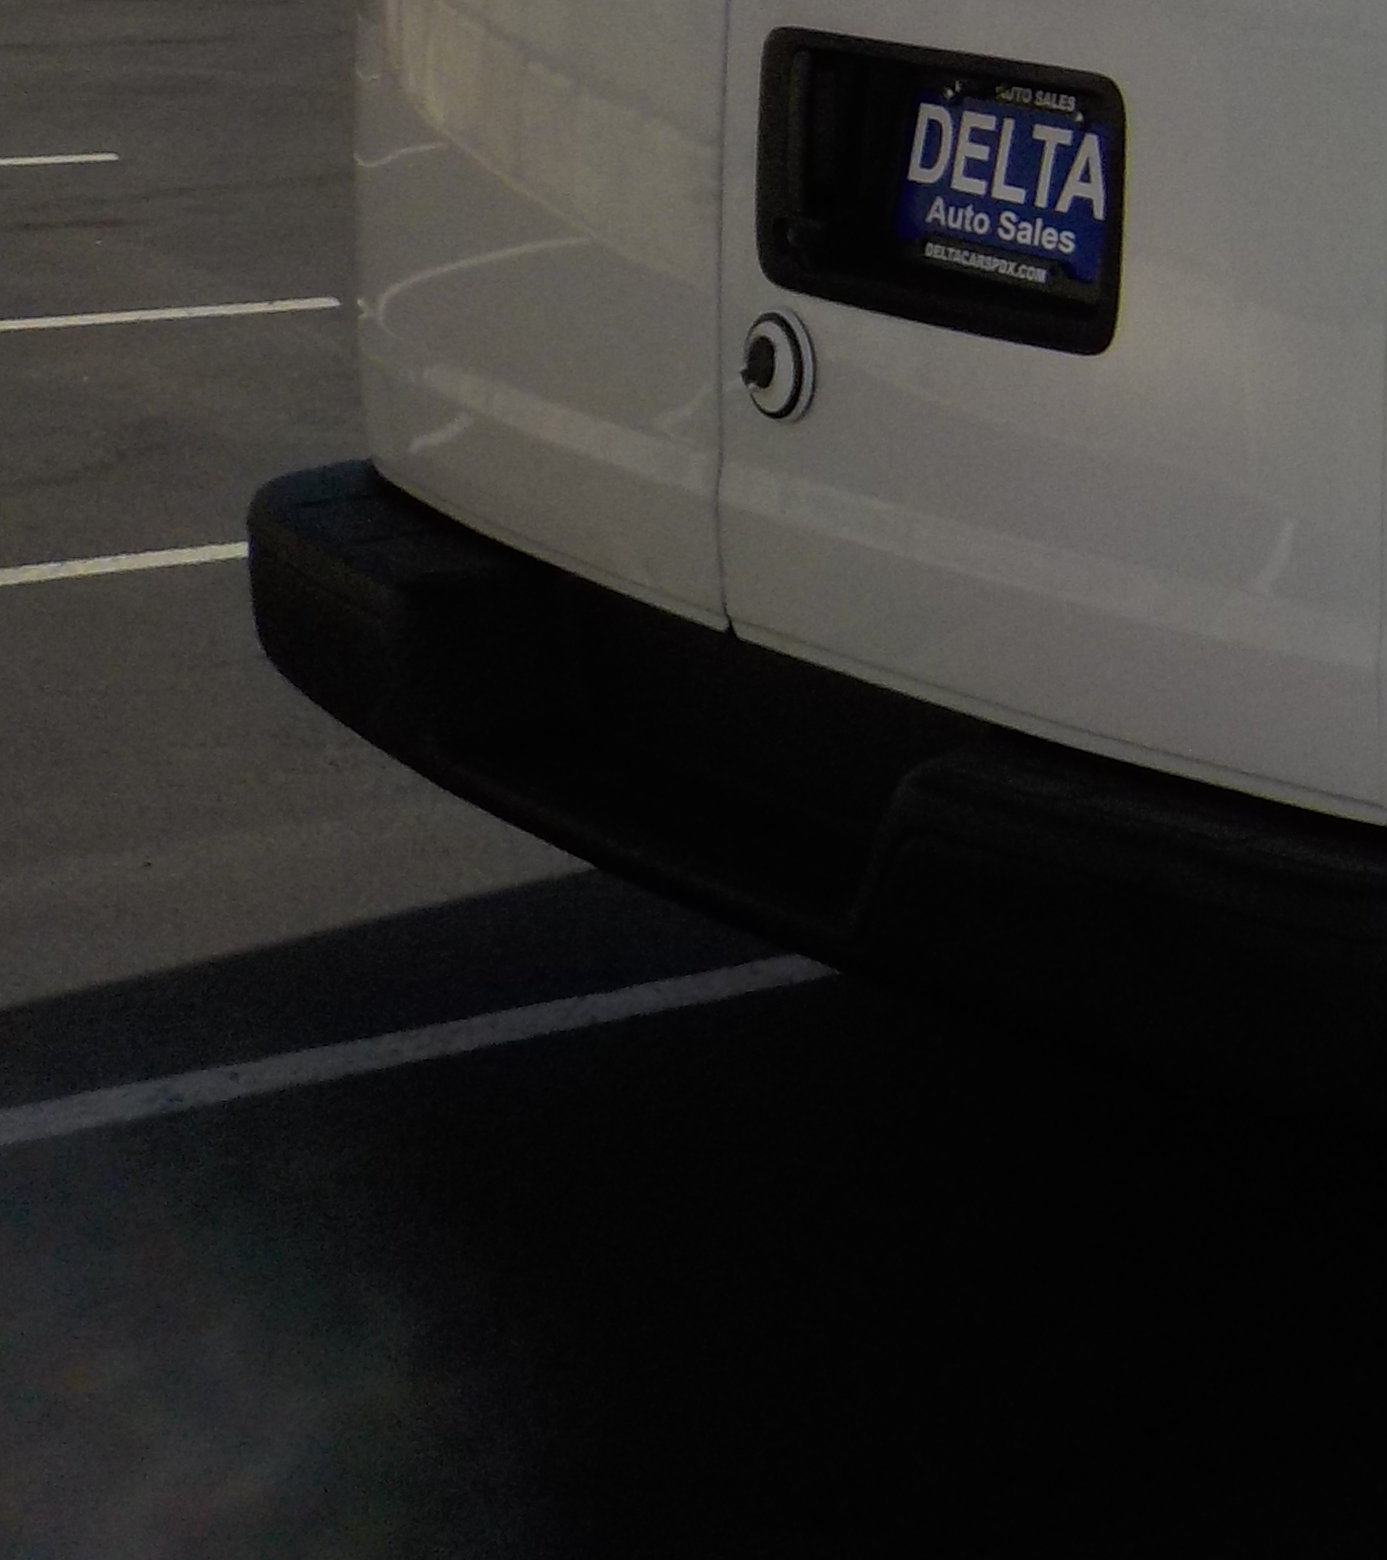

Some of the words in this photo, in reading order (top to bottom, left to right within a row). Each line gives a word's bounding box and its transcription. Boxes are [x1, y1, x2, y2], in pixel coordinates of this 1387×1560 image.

[1034, 89, 1077, 113] SALES
[907, 102, 1106, 221] DELTA
[925, 195, 991, 235] Auto
[998, 210, 1077, 255] Sales
